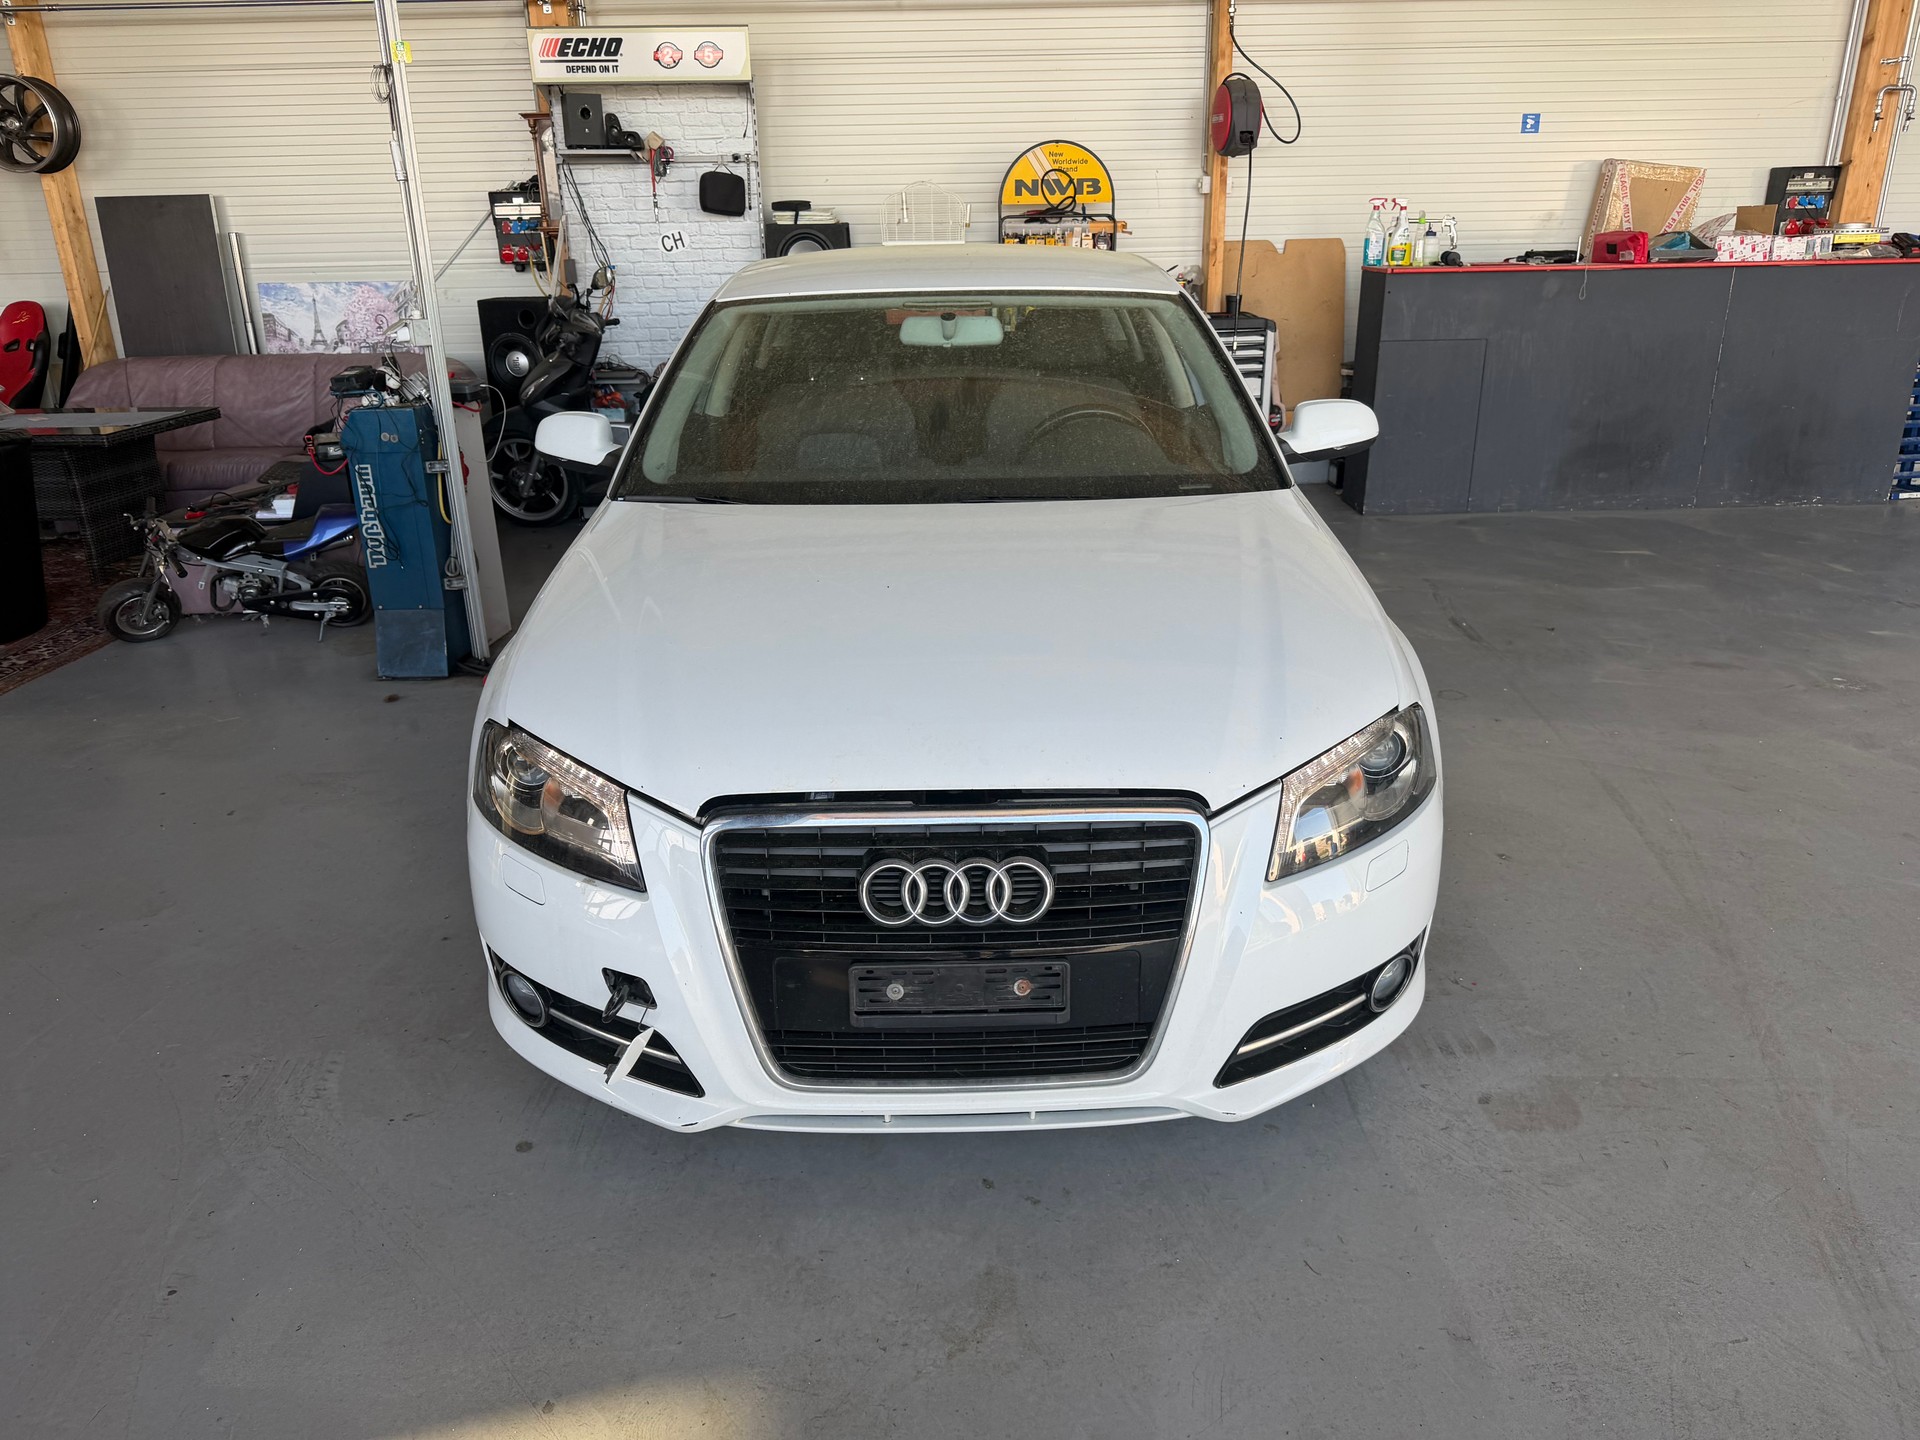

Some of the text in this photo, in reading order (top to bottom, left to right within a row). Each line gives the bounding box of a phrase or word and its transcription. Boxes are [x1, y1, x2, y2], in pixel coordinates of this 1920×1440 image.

[557, 37, 623, 57] ECHO
[565, 65, 619, 74] DEPEND ON IT
[1014, 178, 1102, 196] NWB
[1619, 168, 1629, 199] FRAGIL
[1622, 203, 1631, 224] MUY
[1675, 195, 1691, 217] MUY
[661, 231, 686, 252] CH
